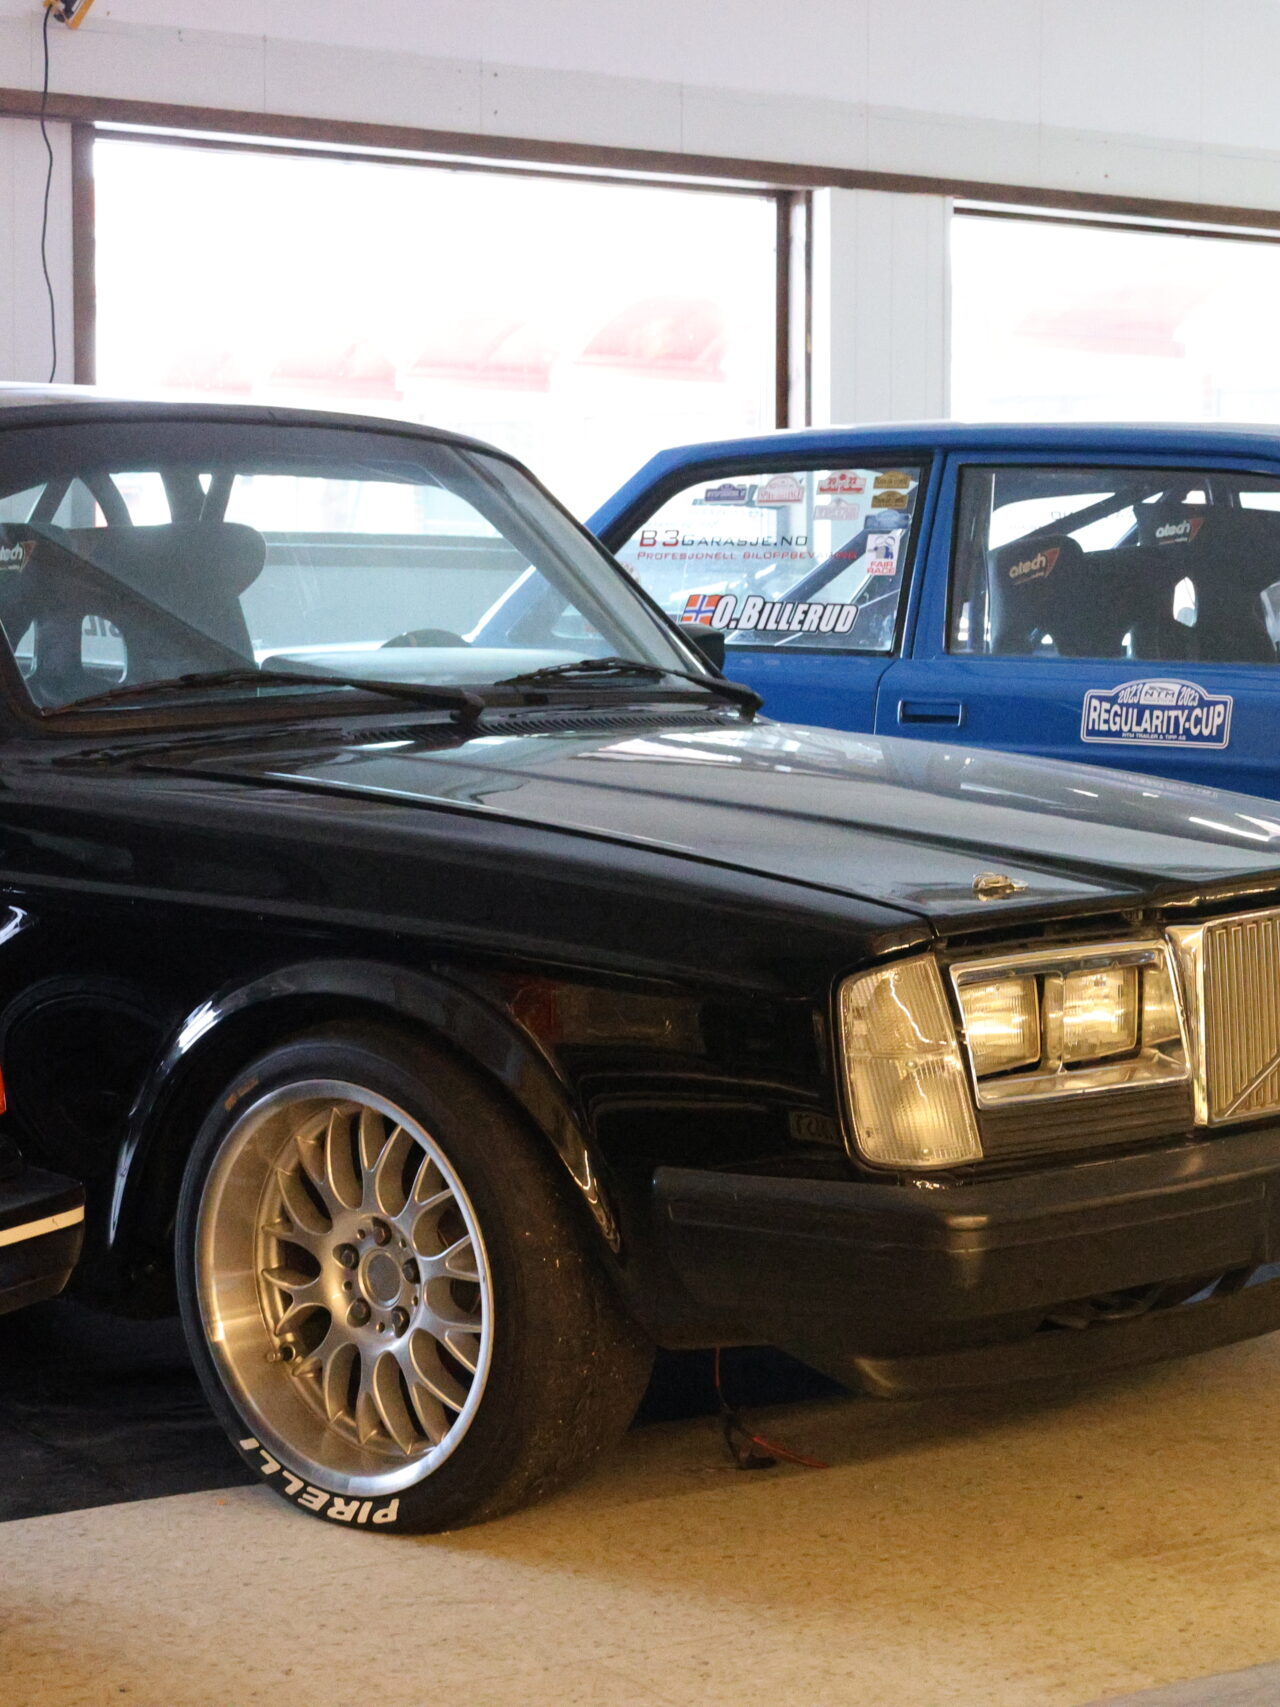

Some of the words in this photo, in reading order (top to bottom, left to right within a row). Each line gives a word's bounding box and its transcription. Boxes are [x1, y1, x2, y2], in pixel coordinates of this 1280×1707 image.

[0, 541, 23, 561] tech
[712, 595, 858, 633] O.BILLERUD
[1118, 683, 1143, 703] 2023
[1177, 686, 1199, 706] 2023
[1088, 697, 1226, 737] REGULARITY-CUP
[239, 1437, 400, 1524] PIRELLI
